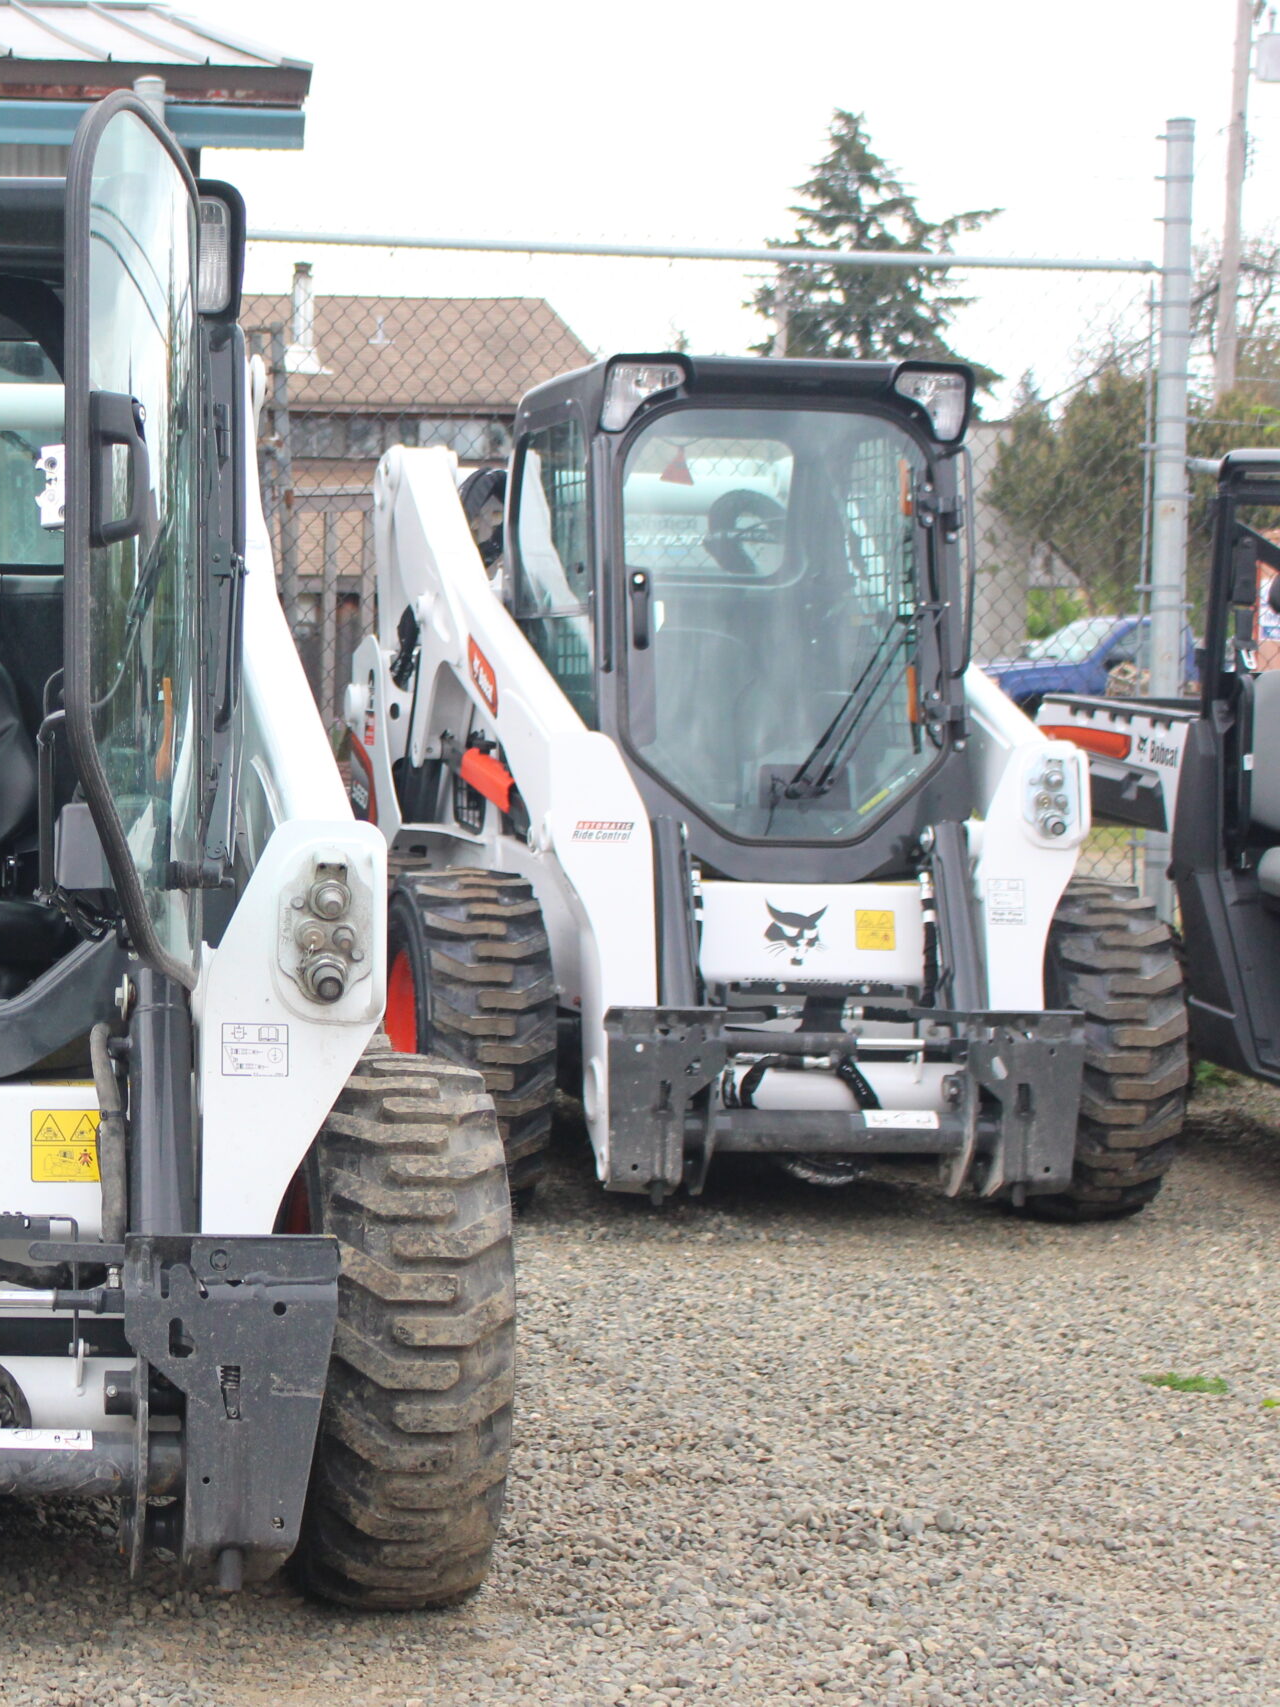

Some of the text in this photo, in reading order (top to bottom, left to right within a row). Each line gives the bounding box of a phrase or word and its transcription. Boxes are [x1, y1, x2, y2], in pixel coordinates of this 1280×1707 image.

[1149, 739, 1179, 769] Bobcat
[572, 830, 632, 841] Ride Control
